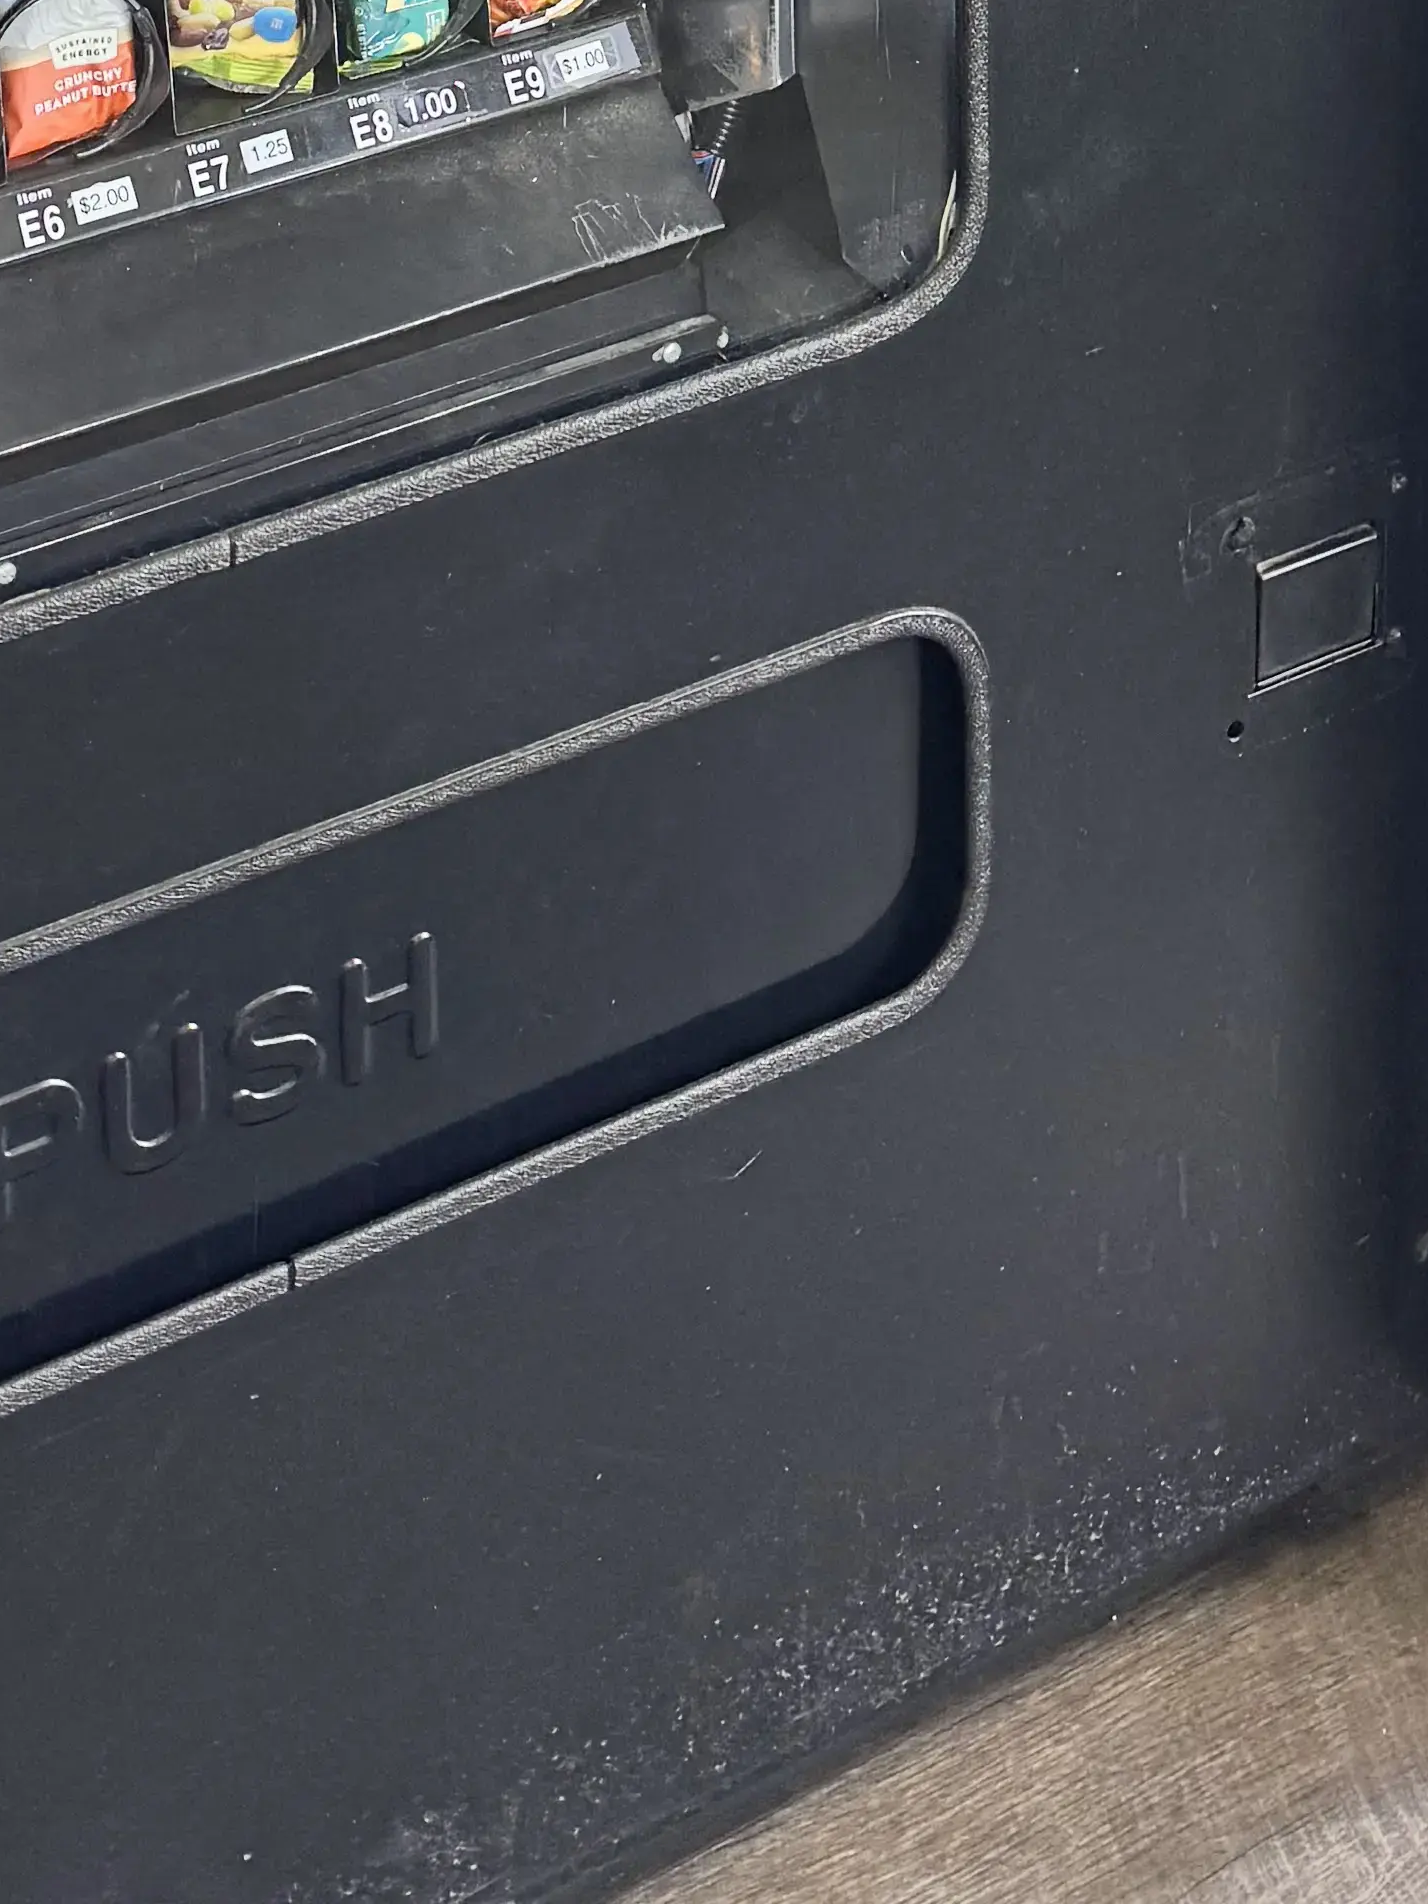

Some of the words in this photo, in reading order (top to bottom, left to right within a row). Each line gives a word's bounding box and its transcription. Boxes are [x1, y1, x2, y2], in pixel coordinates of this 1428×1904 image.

[61, 48, 108, 62] ENERGY
[562, 49, 605, 75] $1.00
[53, 66, 123, 92] CRUNCHY
[504, 65, 546, 106] E9
[34, 86, 88, 116] PEANUT
[403, 88, 457, 125] 1.00
[349, 109, 395, 151] E8
[250, 139, 289, 161] 1.25
[187, 156, 230, 198] E7
[78, 185, 130, 215] $2.00
[17, 205, 66, 249] E6
